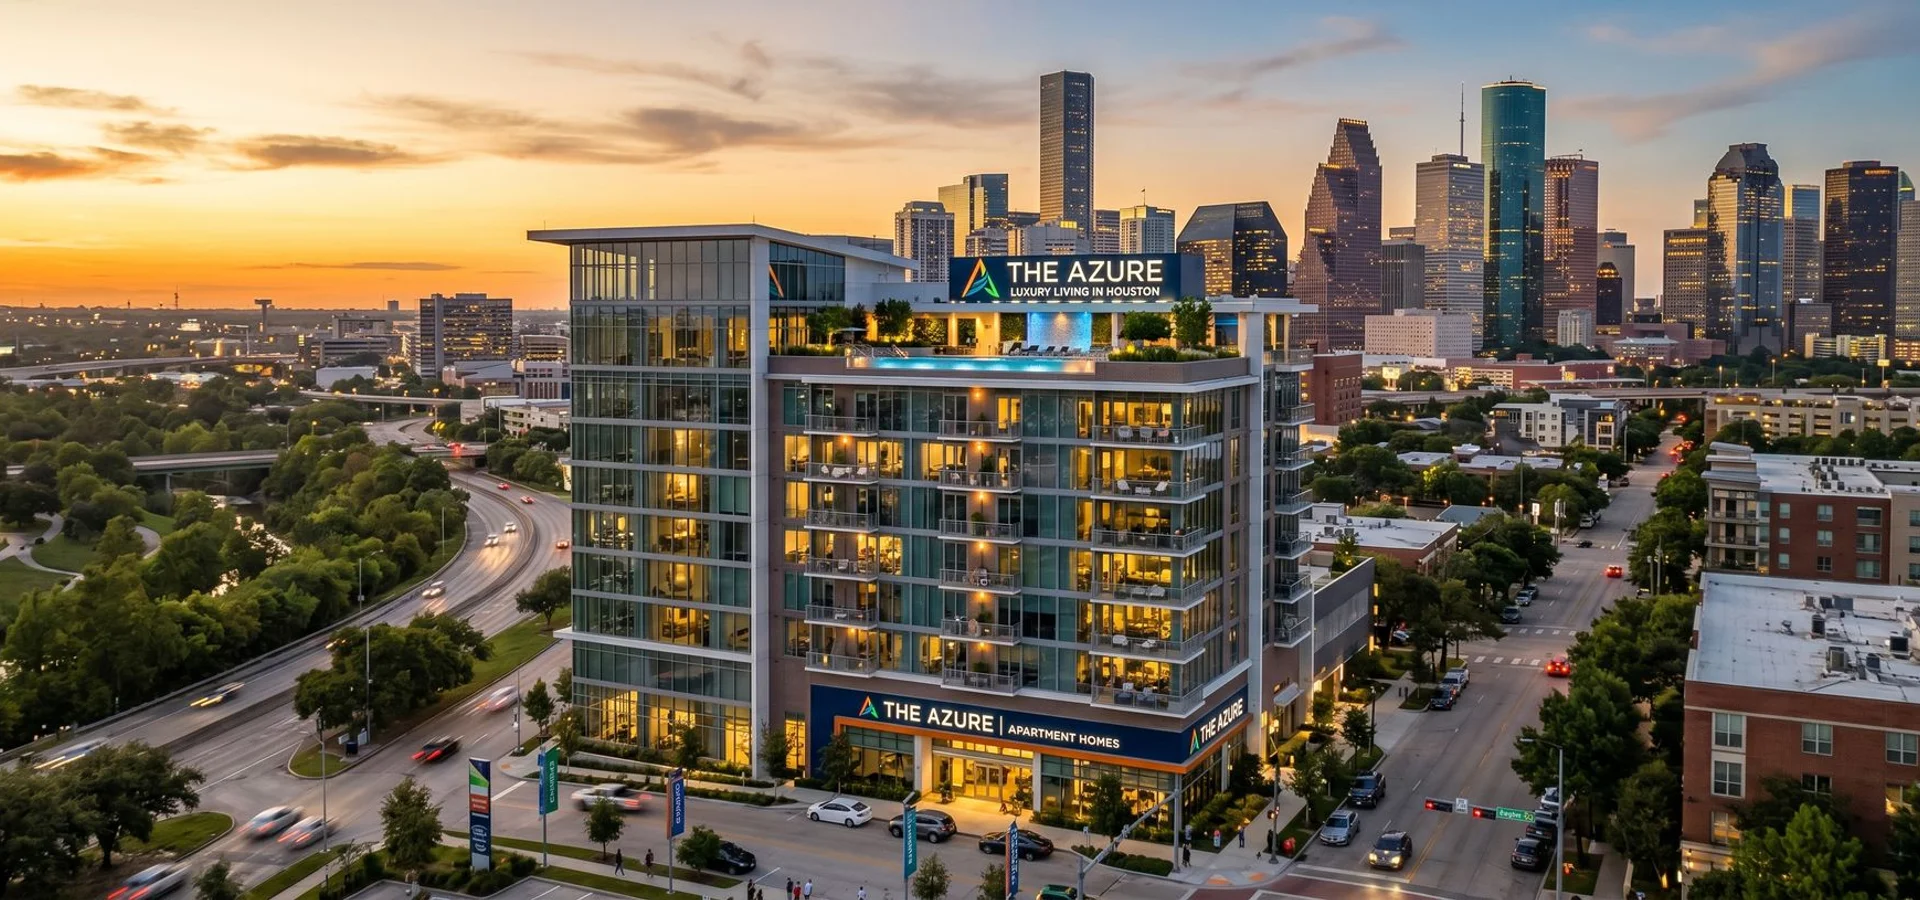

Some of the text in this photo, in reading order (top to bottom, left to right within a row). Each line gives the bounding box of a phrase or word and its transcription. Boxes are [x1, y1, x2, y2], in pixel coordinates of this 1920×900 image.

[1006, 259, 1163, 283] THE AZURE
[1010, 286, 1160, 297] LUXURY LIVING IN HOUSTON
[883, 701, 994, 733] THE AZURE
[1200, 698, 1243, 743] THE AZURE
[1008, 724, 1120, 749] APARTMENT HOMES
